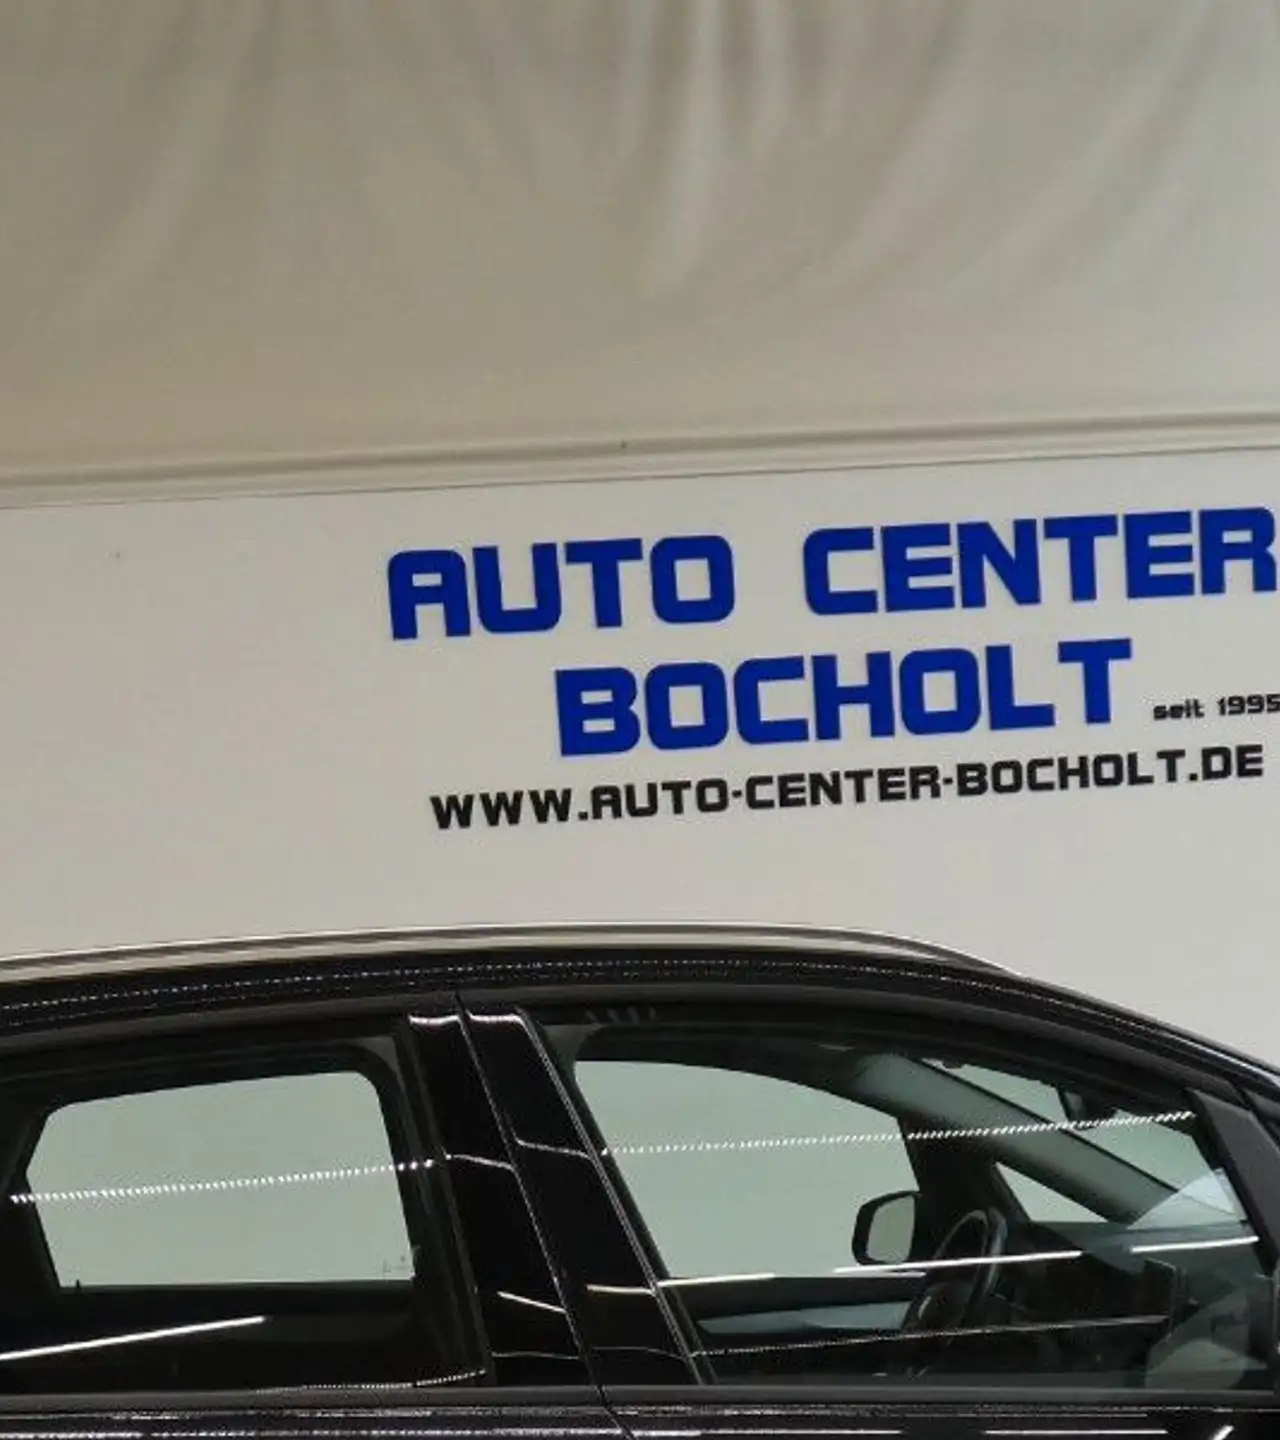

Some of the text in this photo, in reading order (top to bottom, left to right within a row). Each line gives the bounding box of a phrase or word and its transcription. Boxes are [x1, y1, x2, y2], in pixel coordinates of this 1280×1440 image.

[386, 506, 1278, 641] AUTO CENTER
[554, 637, 1133, 758] BOCHOLT
[1153, 698, 1205, 721] seit
[429, 744, 1263, 830] WWW.AUTO-CENTER-BOCHOLT.DE
